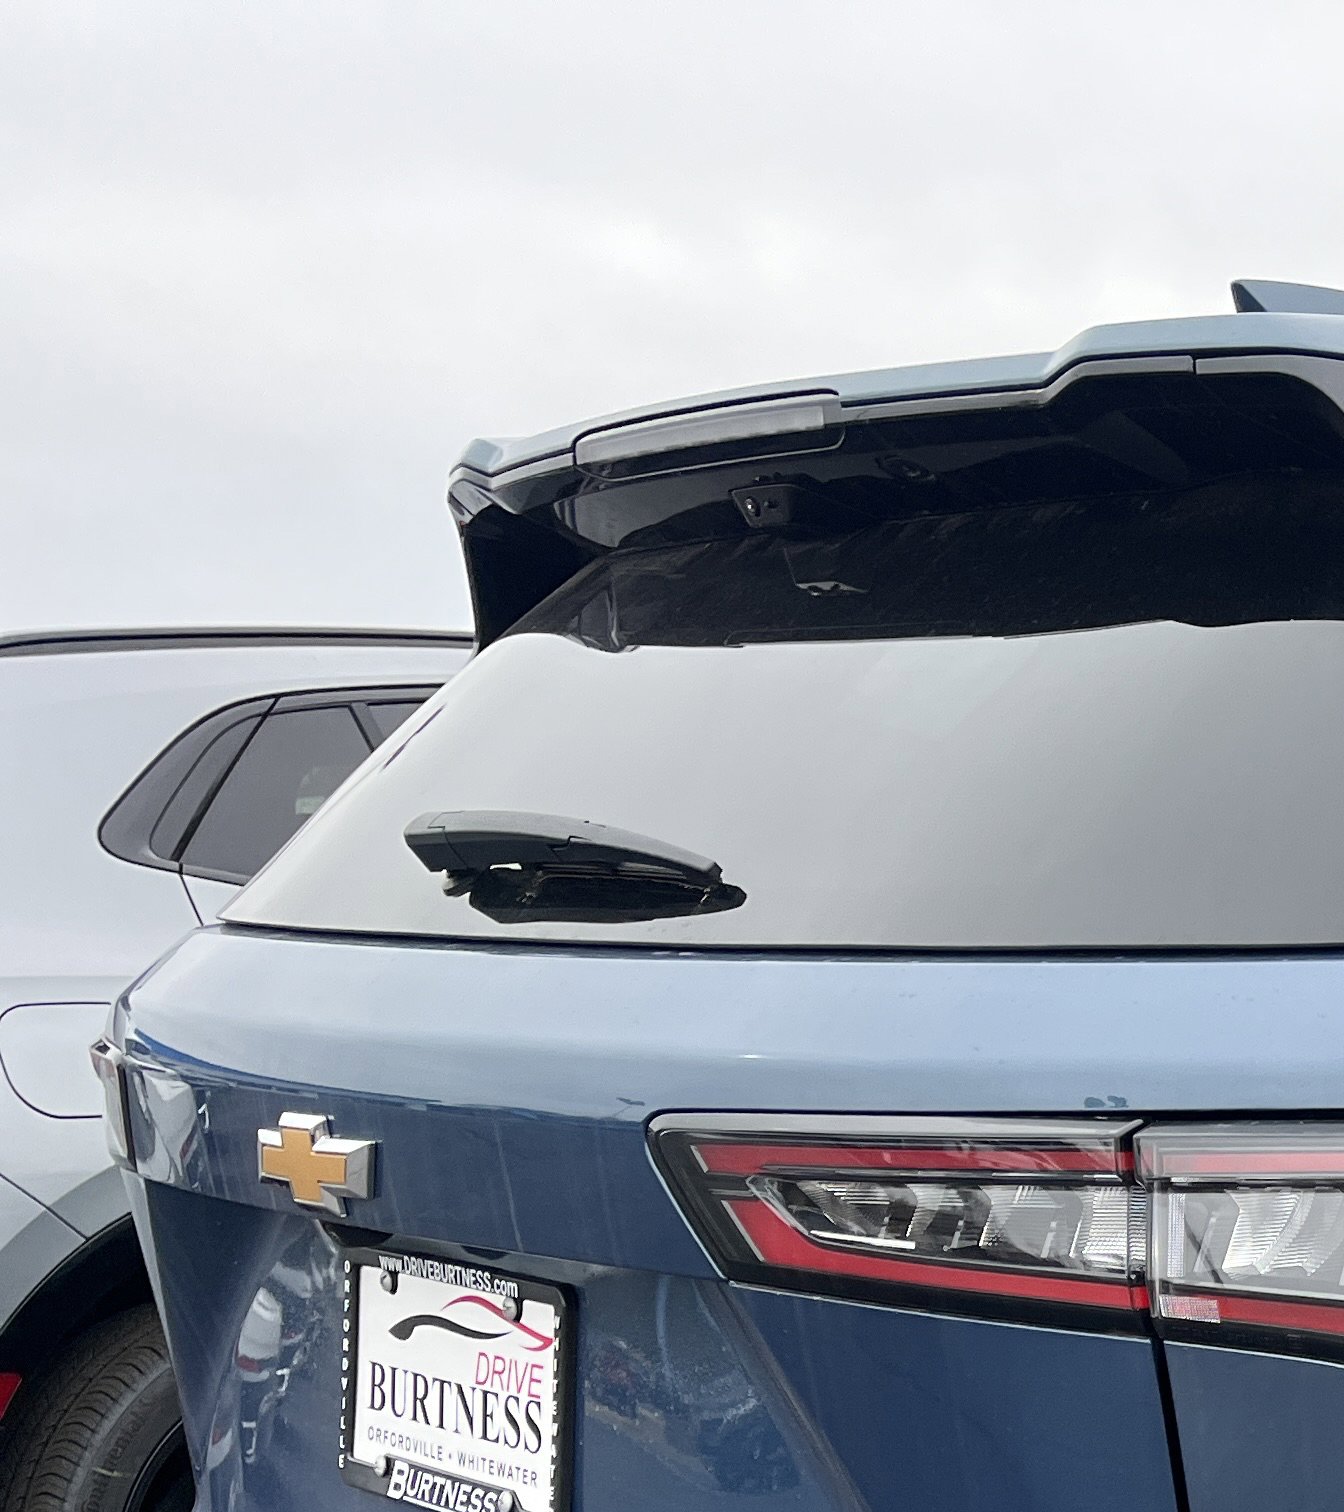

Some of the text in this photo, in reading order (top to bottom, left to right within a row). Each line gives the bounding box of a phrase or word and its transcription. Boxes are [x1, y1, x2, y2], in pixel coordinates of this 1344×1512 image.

[379, 1255, 519, 1298] www.DRIVEBURTNESS.com
[338, 1259, 351, 1470] ORFORDVILLE
[475, 1352, 544, 1399] DRIVE
[368, 1361, 542, 1455] BURTNESS
[367, 1425, 538, 1488] ORFORDVILLE WHITEWATER
